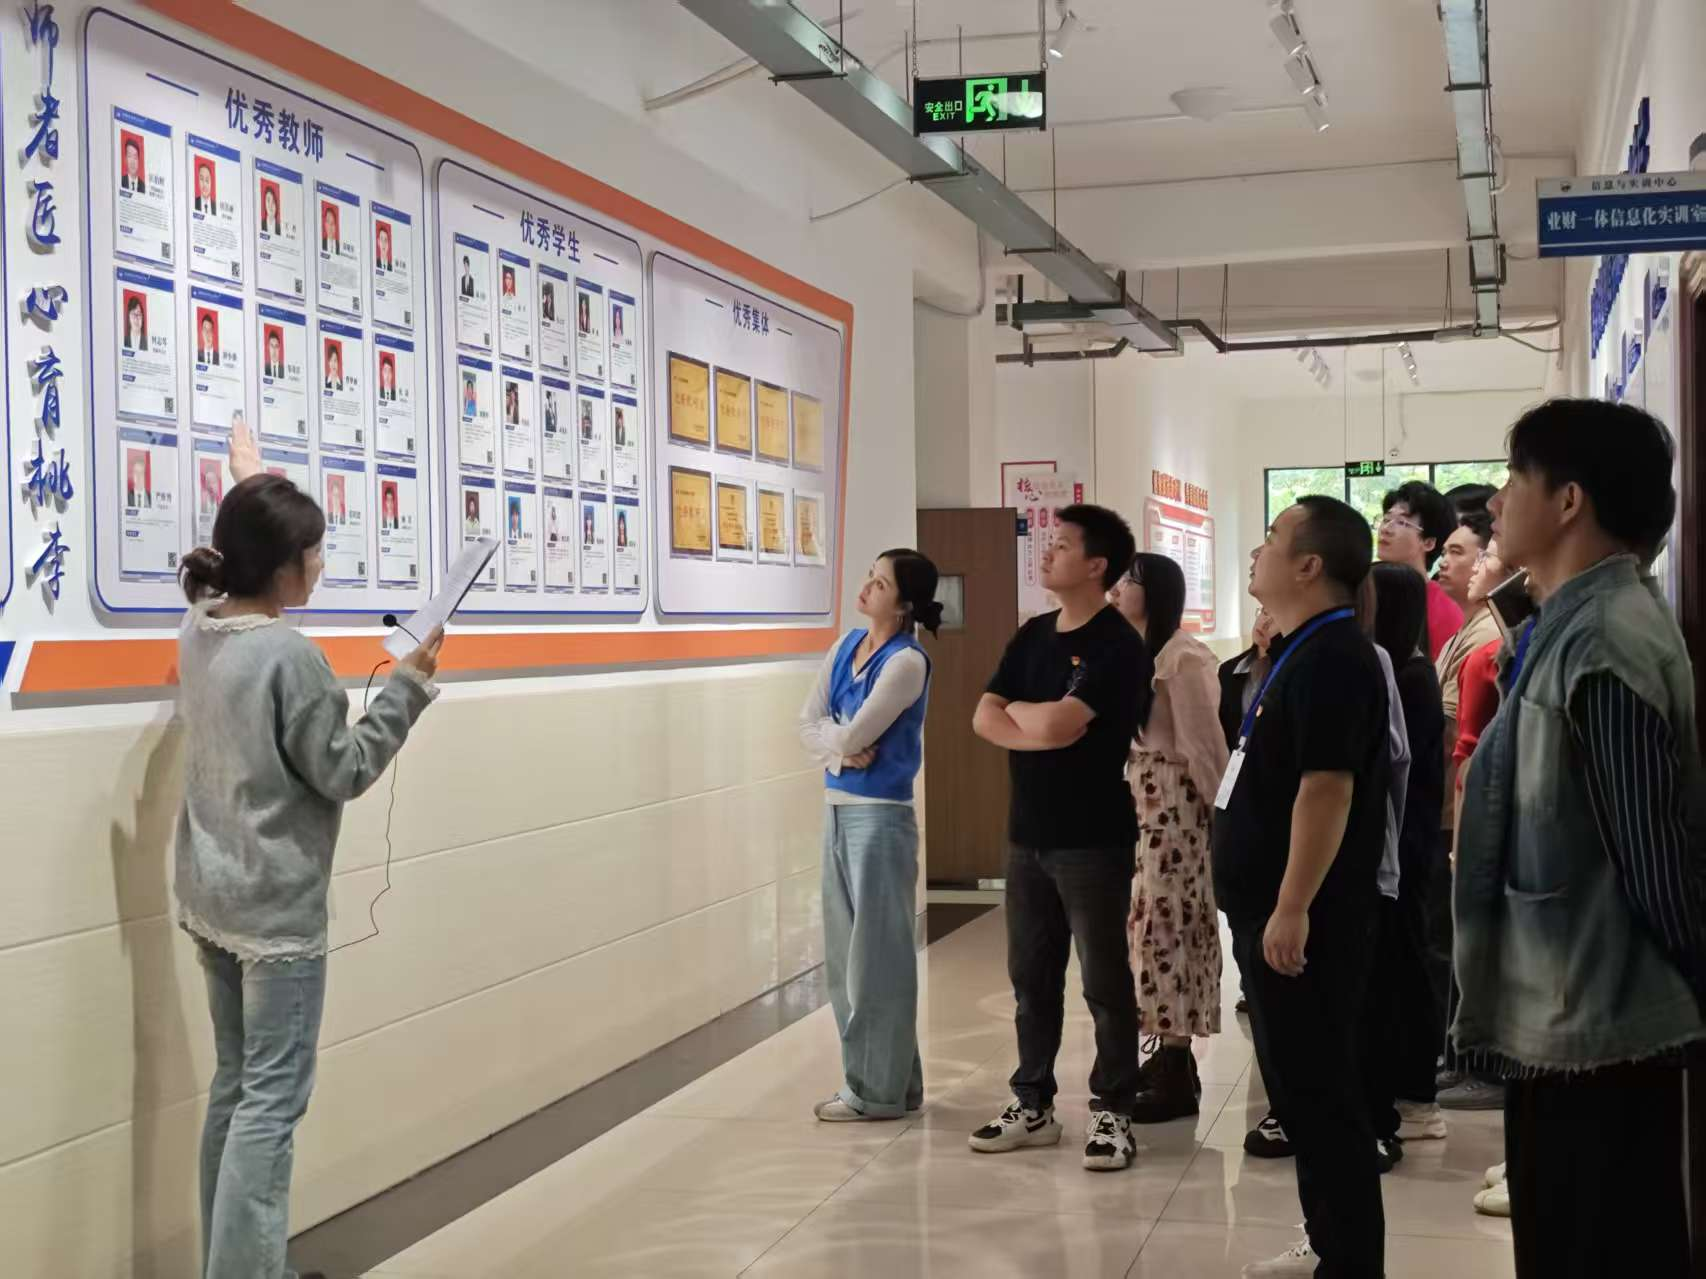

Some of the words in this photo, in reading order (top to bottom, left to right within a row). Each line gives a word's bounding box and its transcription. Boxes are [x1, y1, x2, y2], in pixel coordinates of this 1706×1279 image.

[924, 100, 962, 112] 安全出口
[932, 112, 955, 121] EXIT
[225, 87, 325, 164] 优秀教师
[1591, 177, 1678, 191] 信息与实训中心
[1547, 203, 1706, 231] 业财一体信息化实训室
[520, 209, 581, 263] 优秀学生
[23, 0, 74, 601] 师者匠心育桃李
[732, 298, 770, 338] 优秀集体
